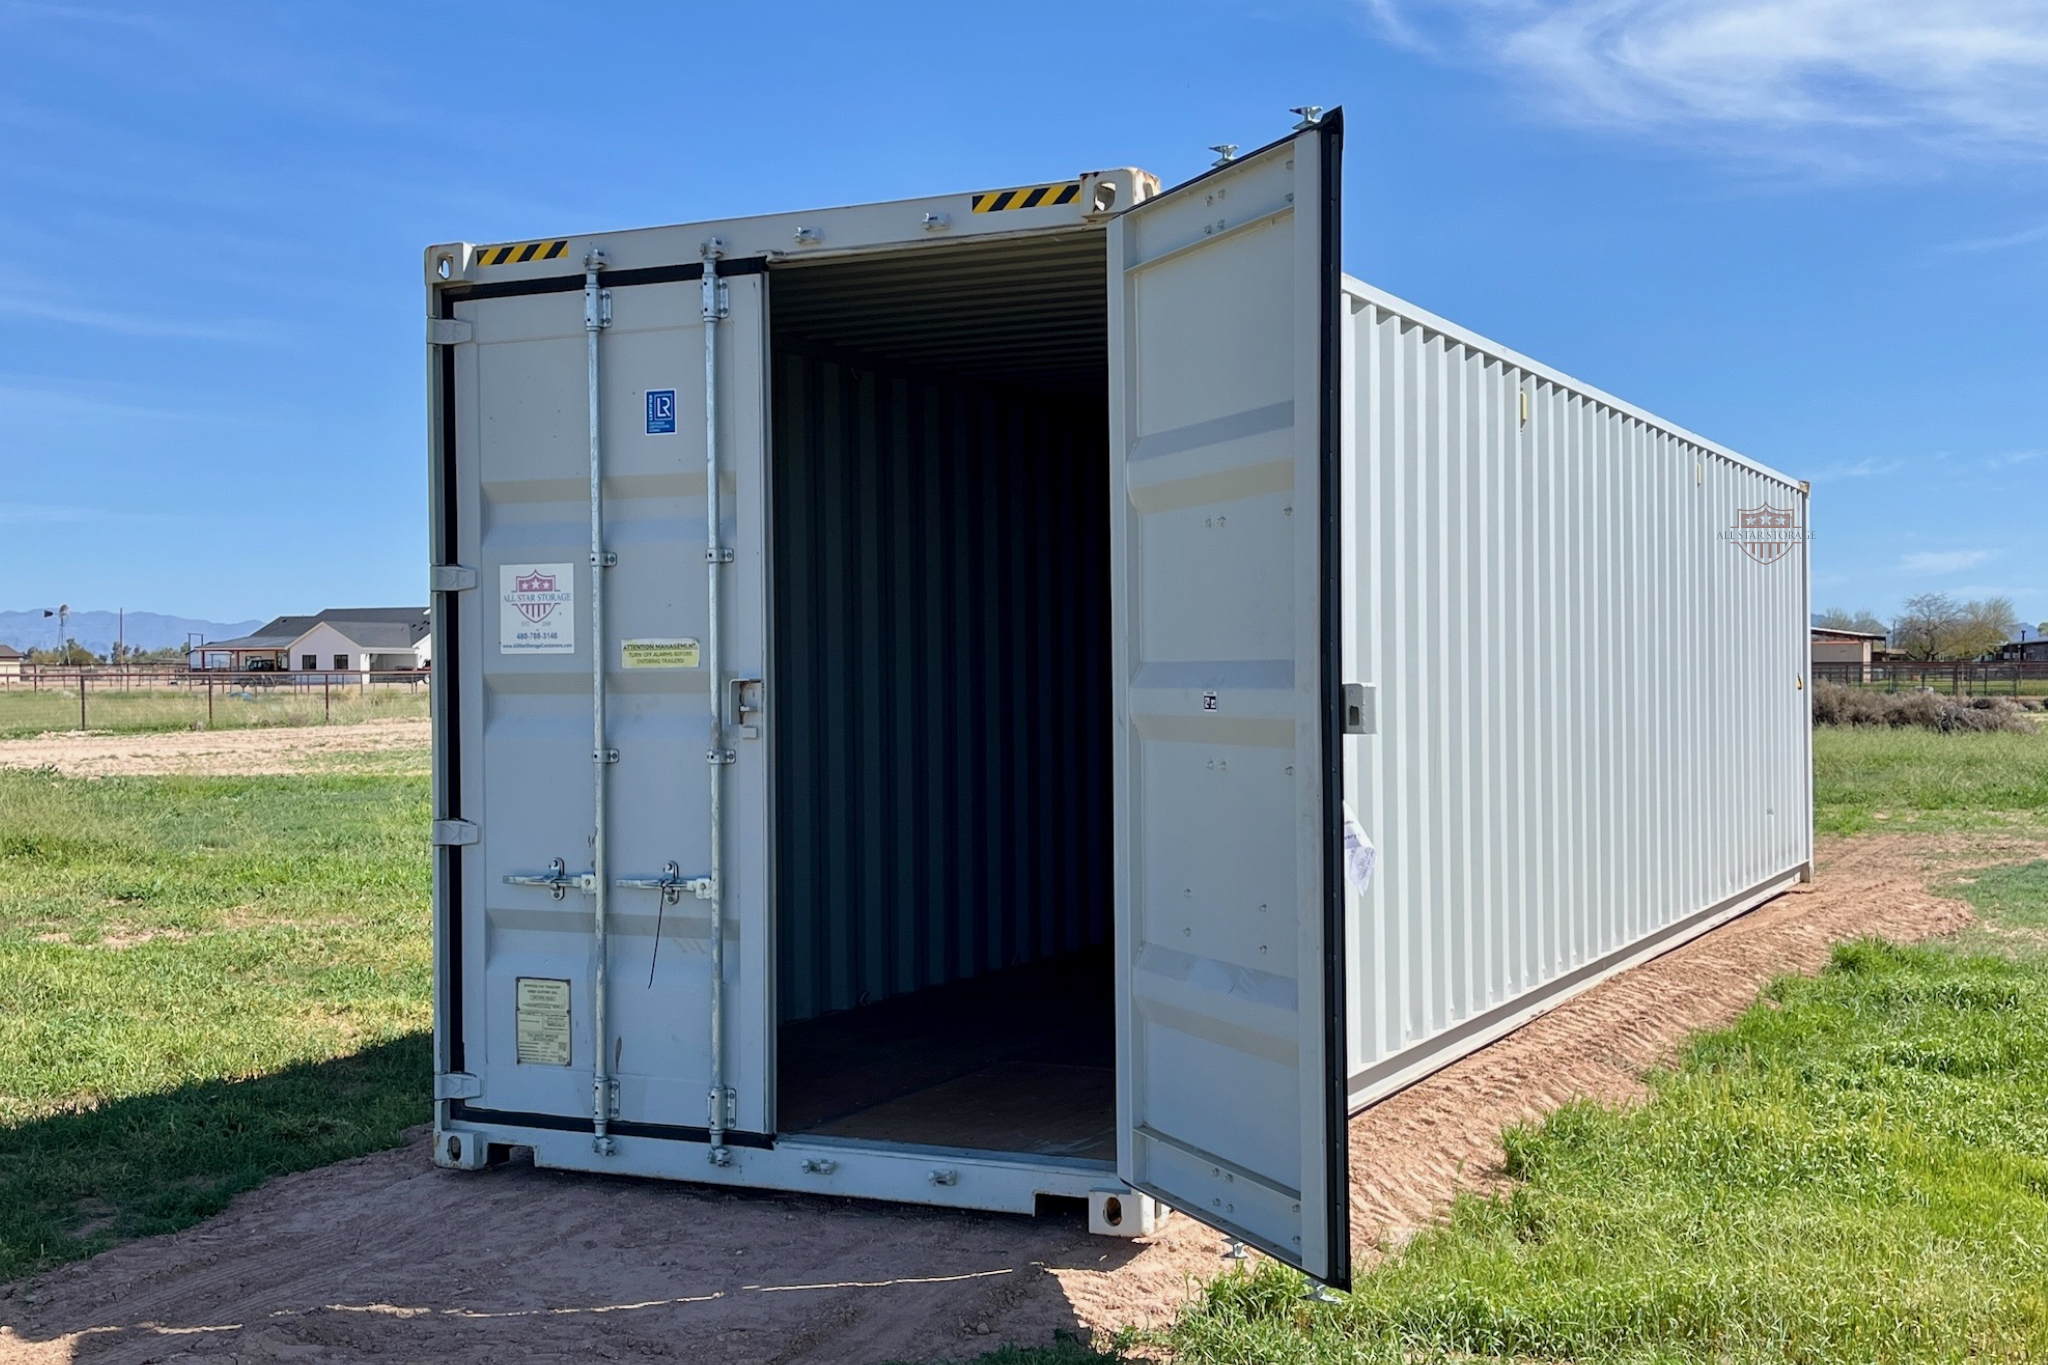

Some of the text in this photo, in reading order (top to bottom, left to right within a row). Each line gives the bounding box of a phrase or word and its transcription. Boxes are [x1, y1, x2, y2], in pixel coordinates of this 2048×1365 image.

[657, 397, 671, 417] LR
[517, 594, 535, 602] STAR
[537, 593, 571, 602] STORAGE
